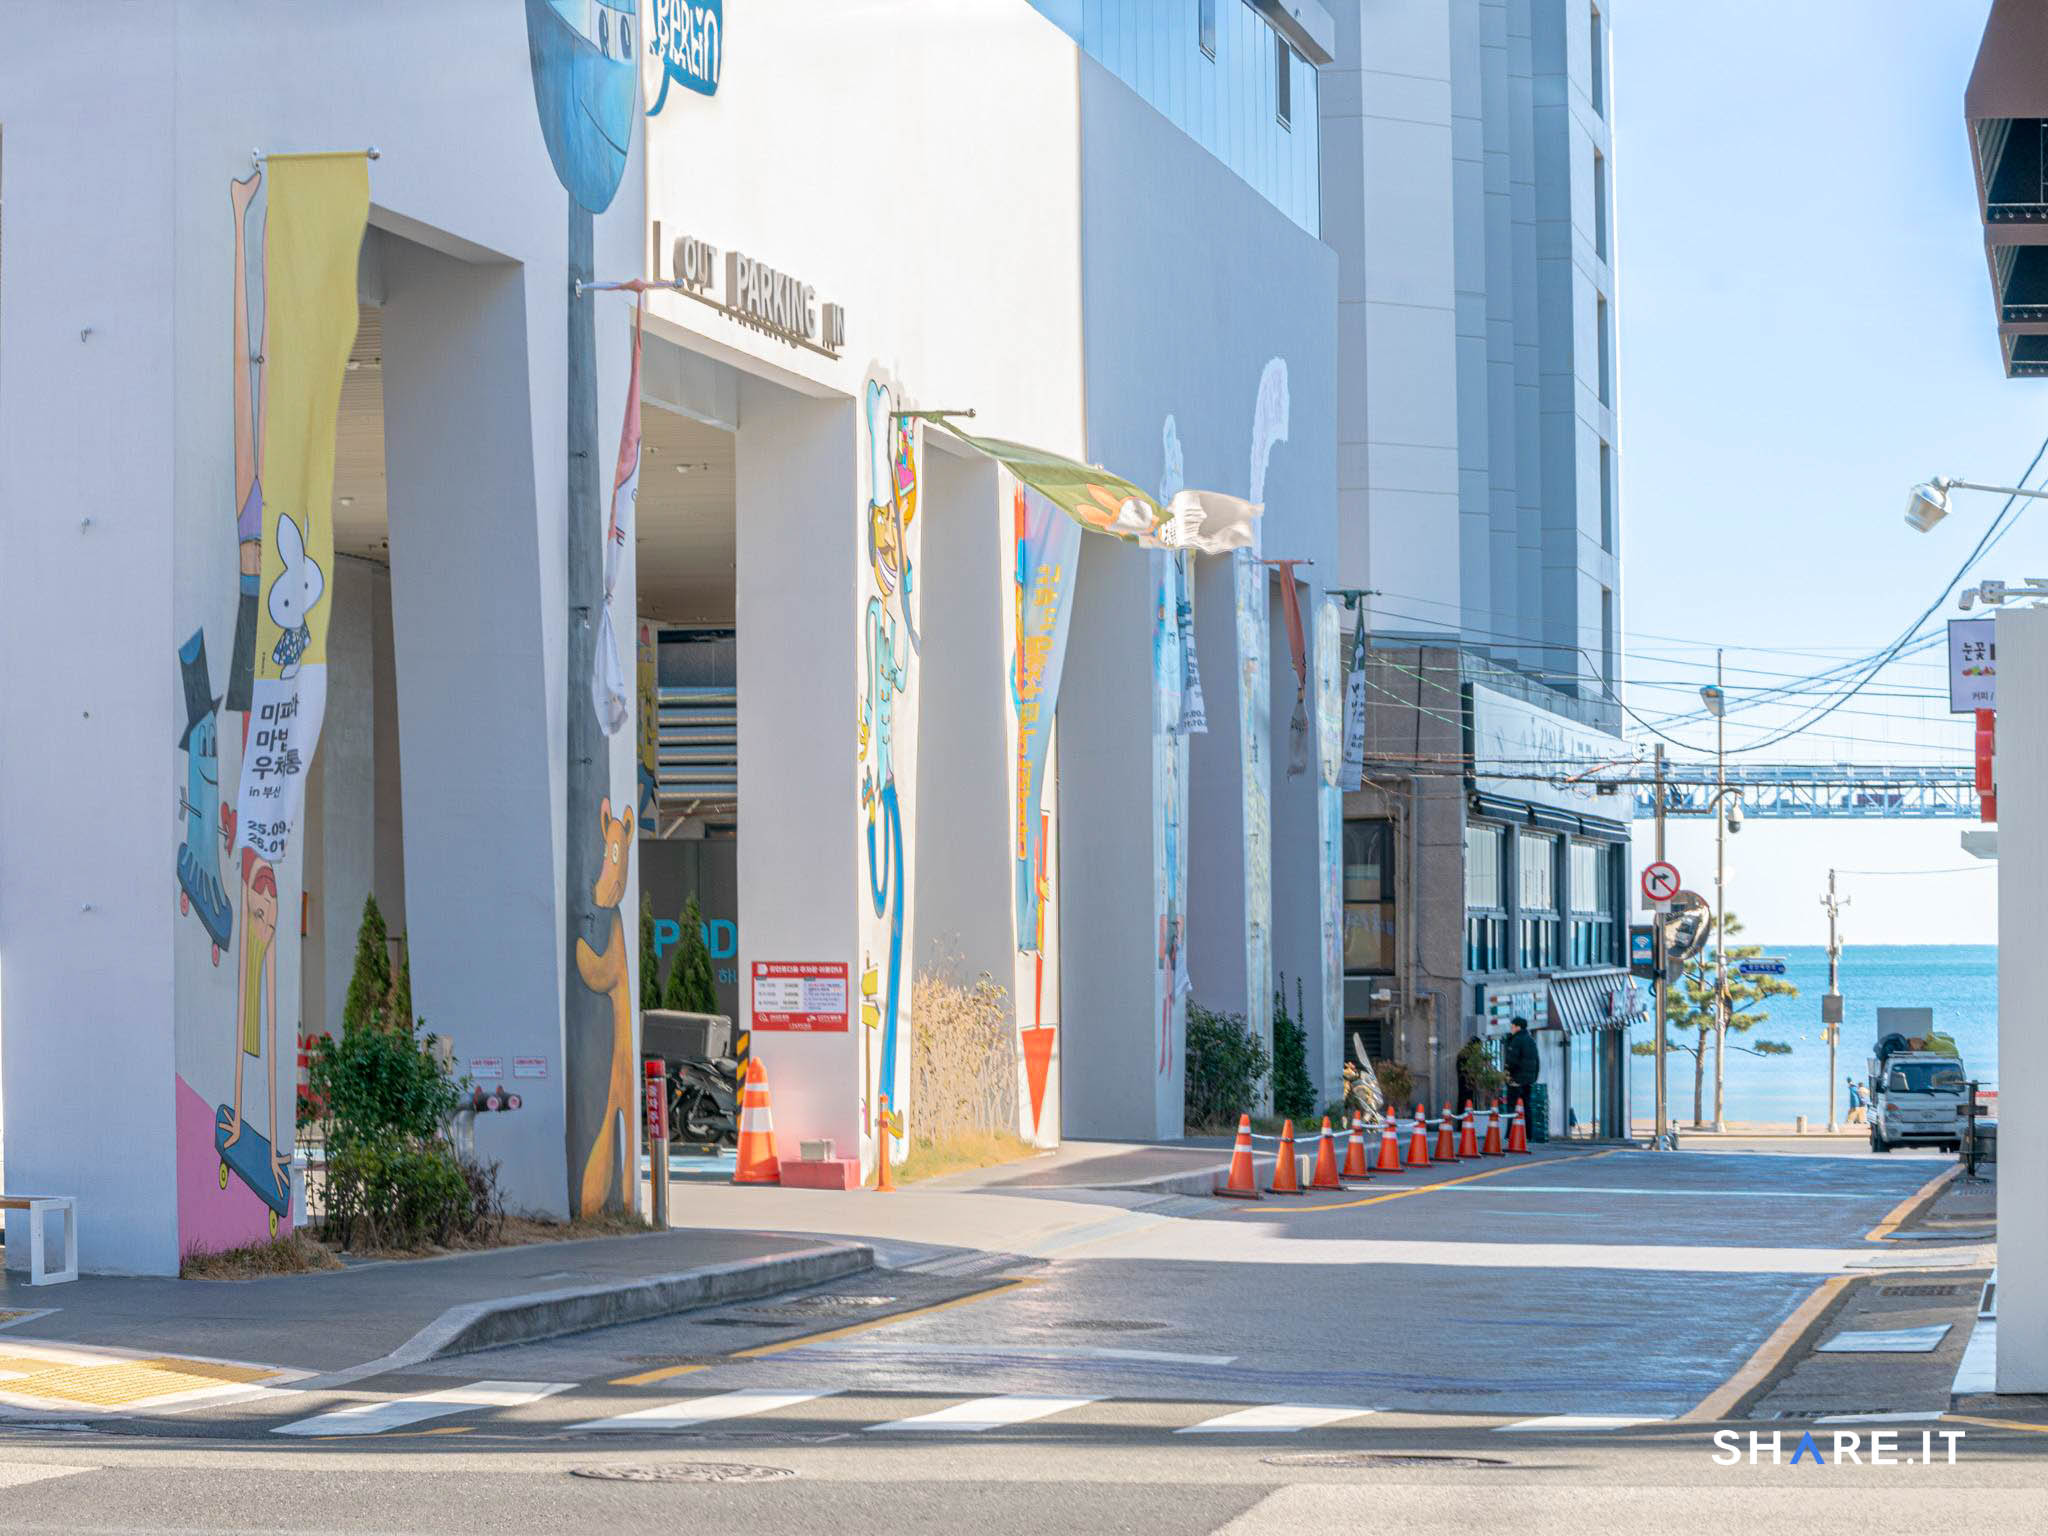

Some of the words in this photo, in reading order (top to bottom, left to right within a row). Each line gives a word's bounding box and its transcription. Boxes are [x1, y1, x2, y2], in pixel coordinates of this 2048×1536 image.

[675, 235, 717, 286] OUT
[728, 251, 817, 340] PARKING
[823, 302, 845, 347] IN
[1962, 641, 1986, 662] 눈꽃
[1972, 691, 1989, 701] 커피
[248, 786, 260, 797] in
